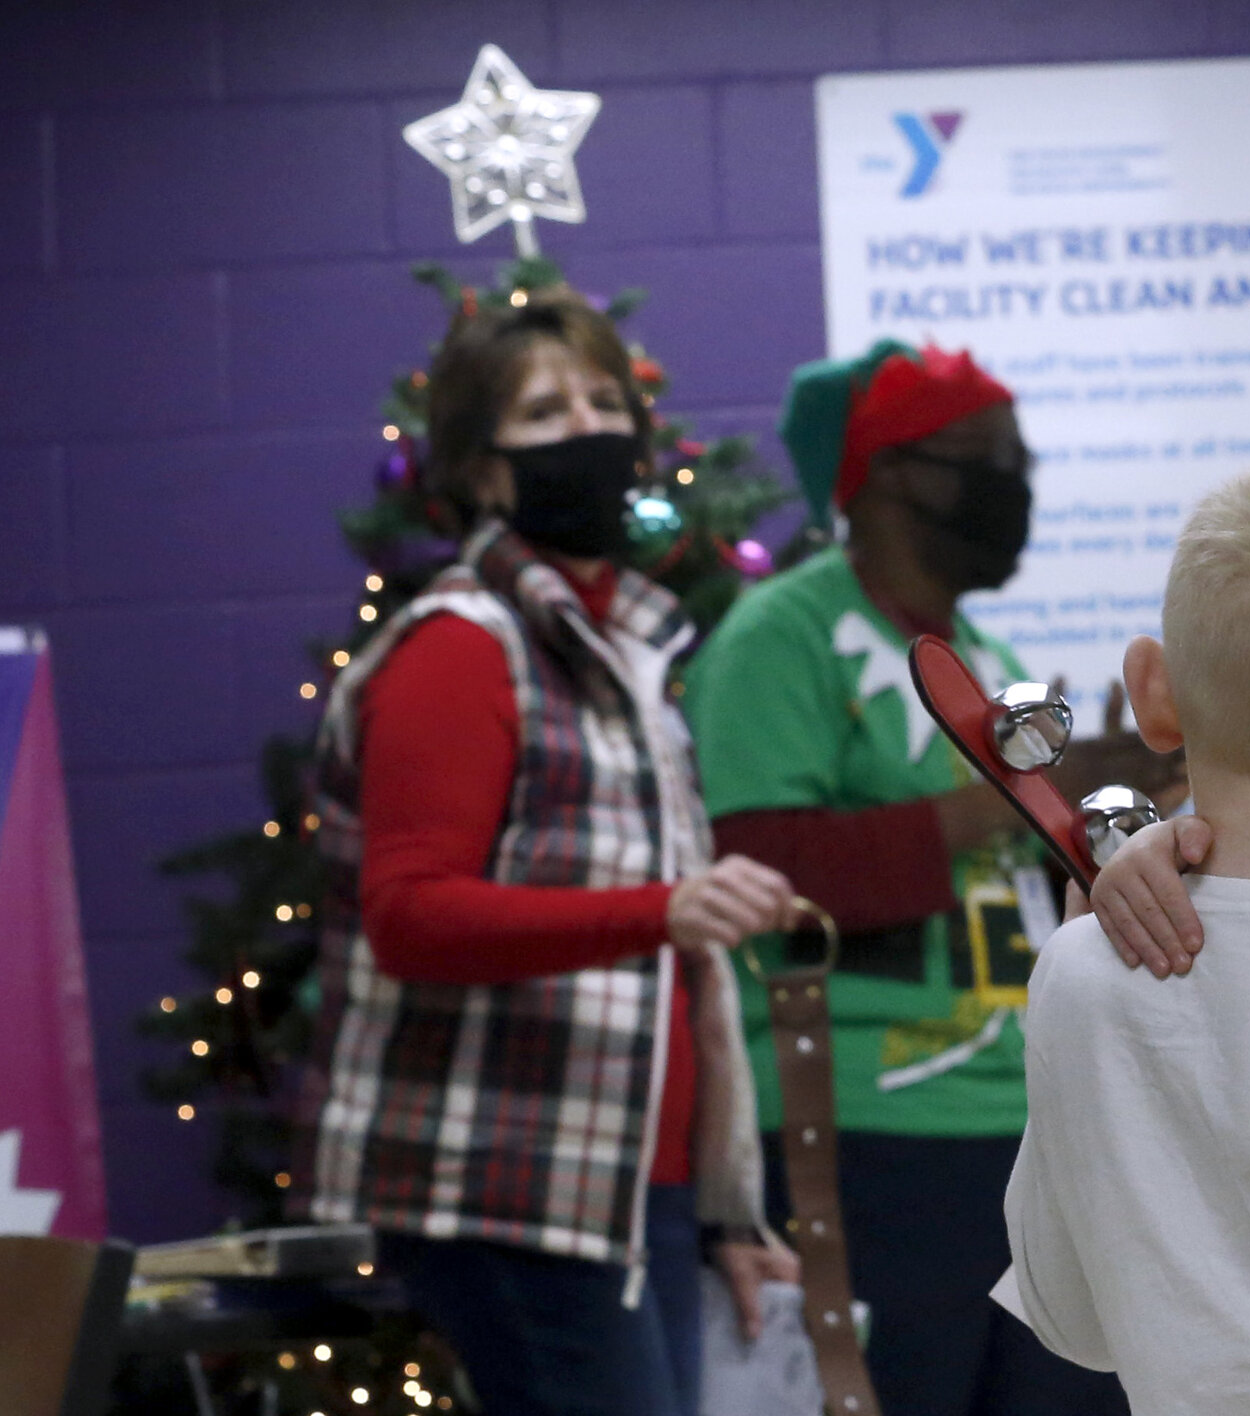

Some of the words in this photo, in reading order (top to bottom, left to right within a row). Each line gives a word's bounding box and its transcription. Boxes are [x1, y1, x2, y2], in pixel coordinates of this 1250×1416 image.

[867, 233, 969, 269] HOW
[978, 228, 1109, 266] WE'RE
[868, 282, 1043, 324] FACILITY
[1059, 277, 1194, 316] CLEAN
